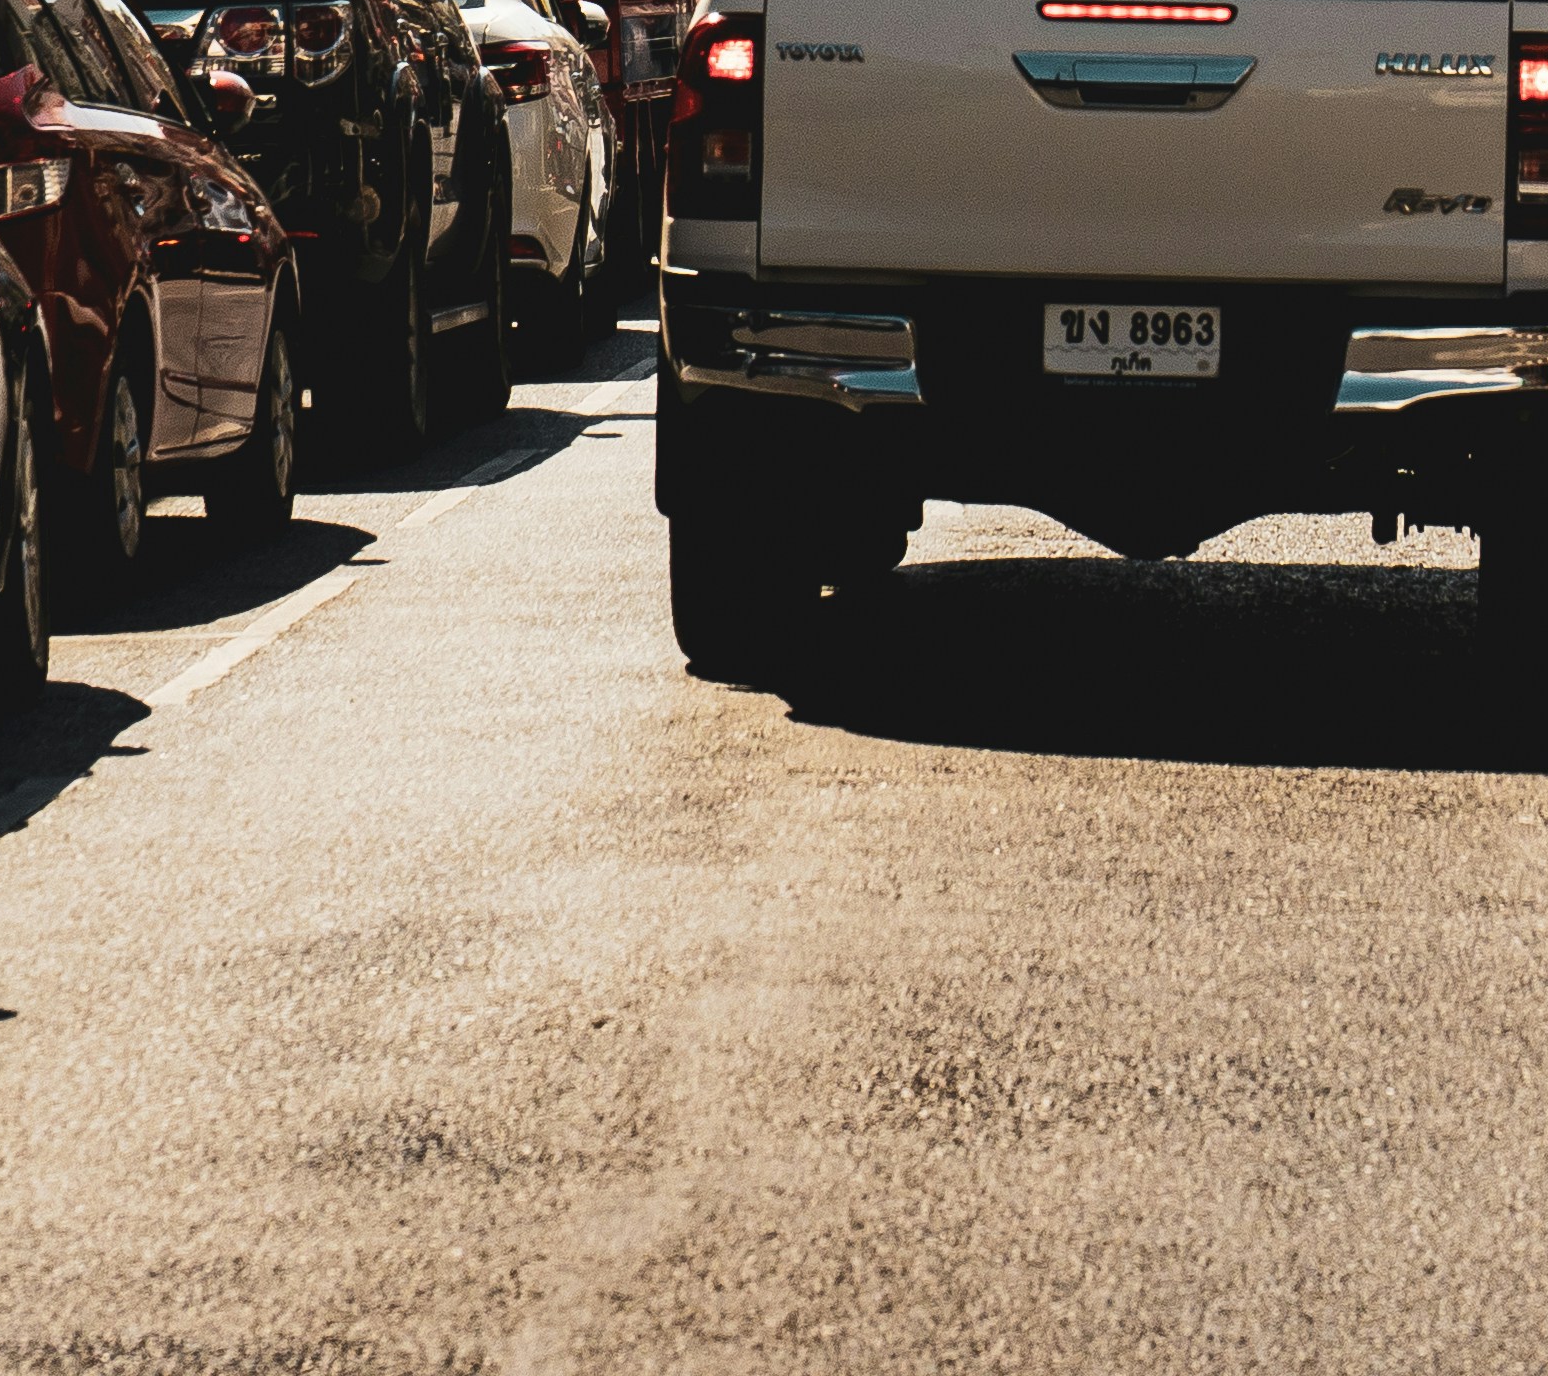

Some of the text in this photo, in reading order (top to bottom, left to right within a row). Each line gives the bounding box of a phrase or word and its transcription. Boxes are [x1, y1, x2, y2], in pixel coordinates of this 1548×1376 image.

[776, 42, 865, 63] TOYOTA
[1375, 52, 1495, 77] HILUX
[1060, 309, 1215, 346] ขง 8963
[1111, 351, 1152, 375] ภูเก็ต
